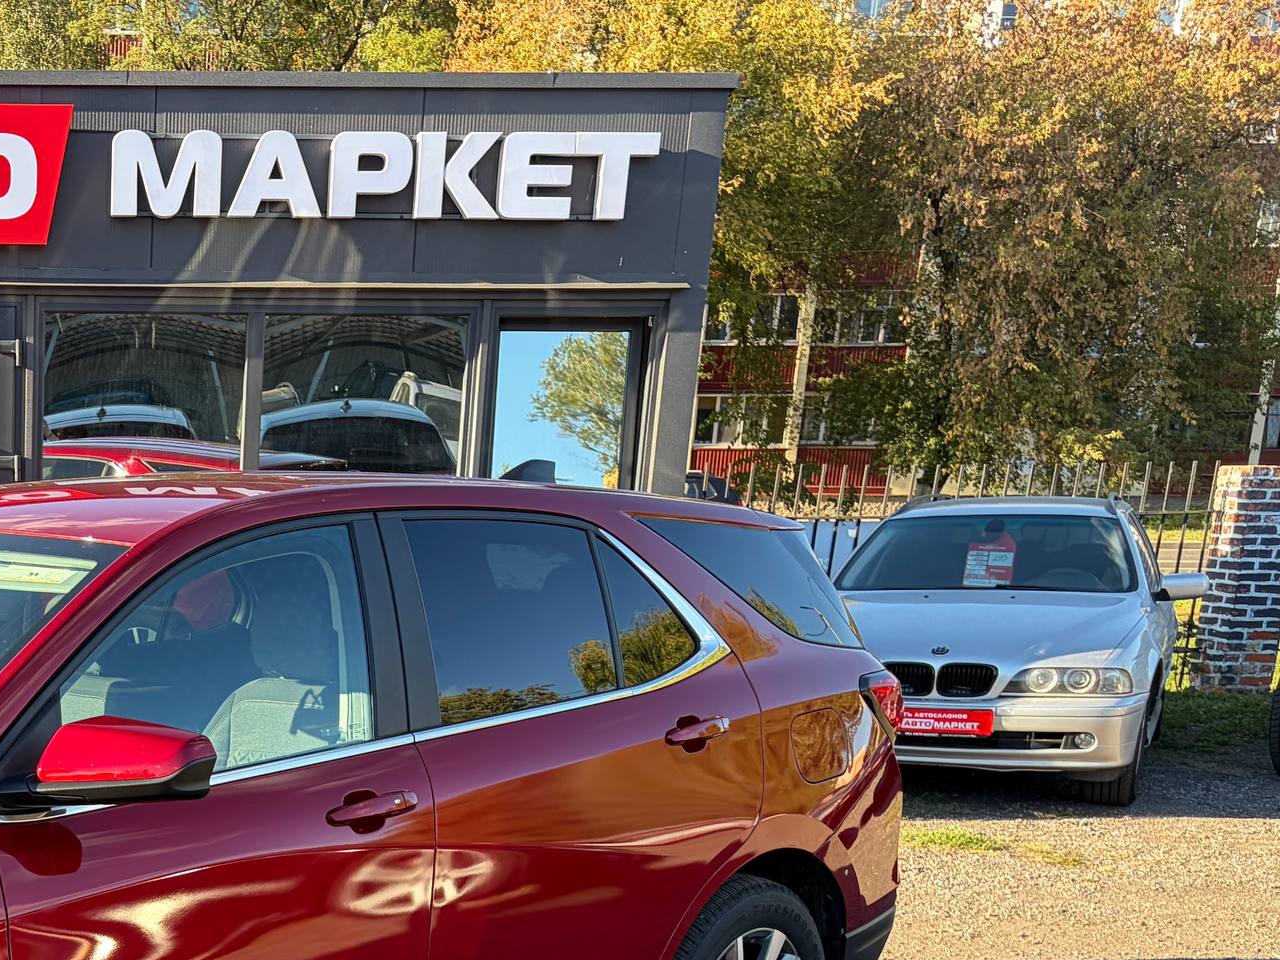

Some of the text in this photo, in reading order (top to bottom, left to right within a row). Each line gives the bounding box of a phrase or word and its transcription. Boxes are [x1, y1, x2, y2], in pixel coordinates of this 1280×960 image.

[111, 129, 661, 220] МАРКЕТ
[903, 719, 980, 730] АВТО МАРКЕТ
